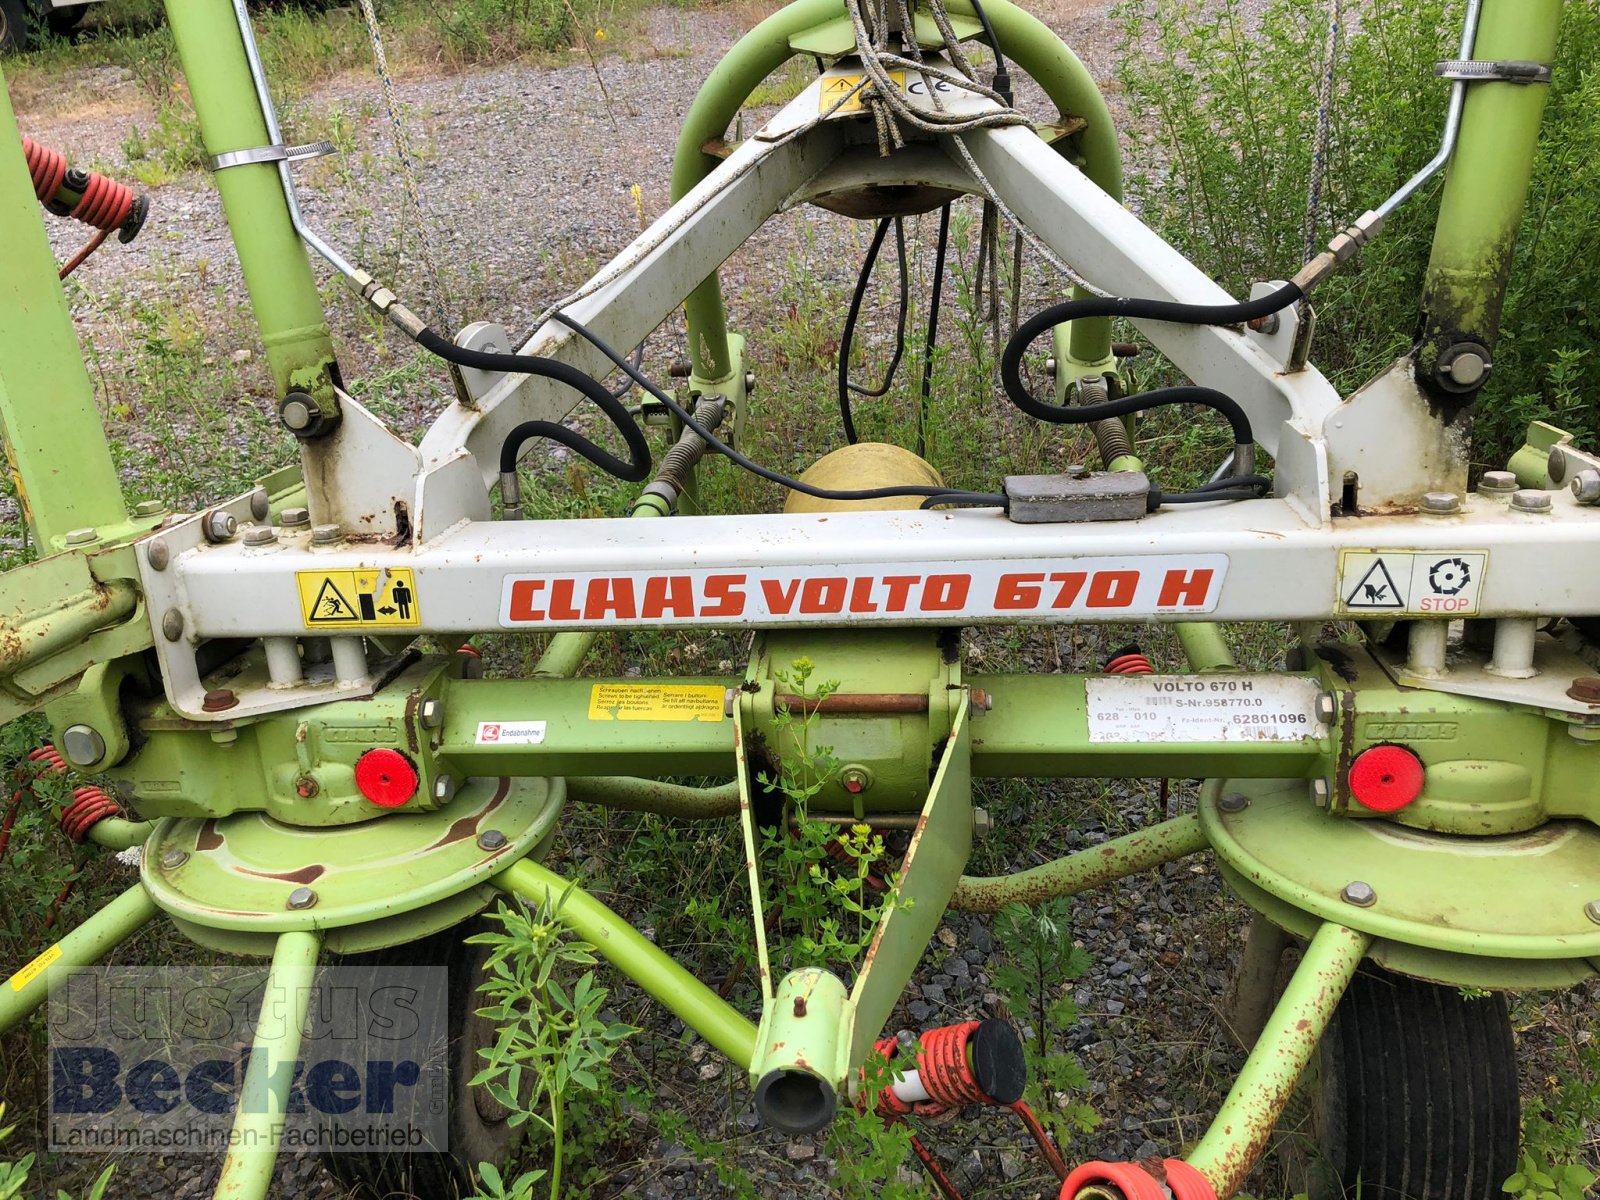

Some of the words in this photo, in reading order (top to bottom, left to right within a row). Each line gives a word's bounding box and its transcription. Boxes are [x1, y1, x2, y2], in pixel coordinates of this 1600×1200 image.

[509, 574, 747, 621] CLAAS
[760, 573, 972, 615] VOLTO
[993, 570, 1140, 610] 670
[1157, 568, 1214, 607] H
[1420, 598, 1469, 611] STOP
[1153, 681, 1205, 692] VOLTO
[1210, 681, 1237, 691] 670
[1242, 681, 1253, 691] H
[1097, 712, 1120, 721] 628
[1134, 712, 1157, 721] 010
[1233, 713, 1307, 724] 62801096
[501, 728, 541, 737] Endabnahme
